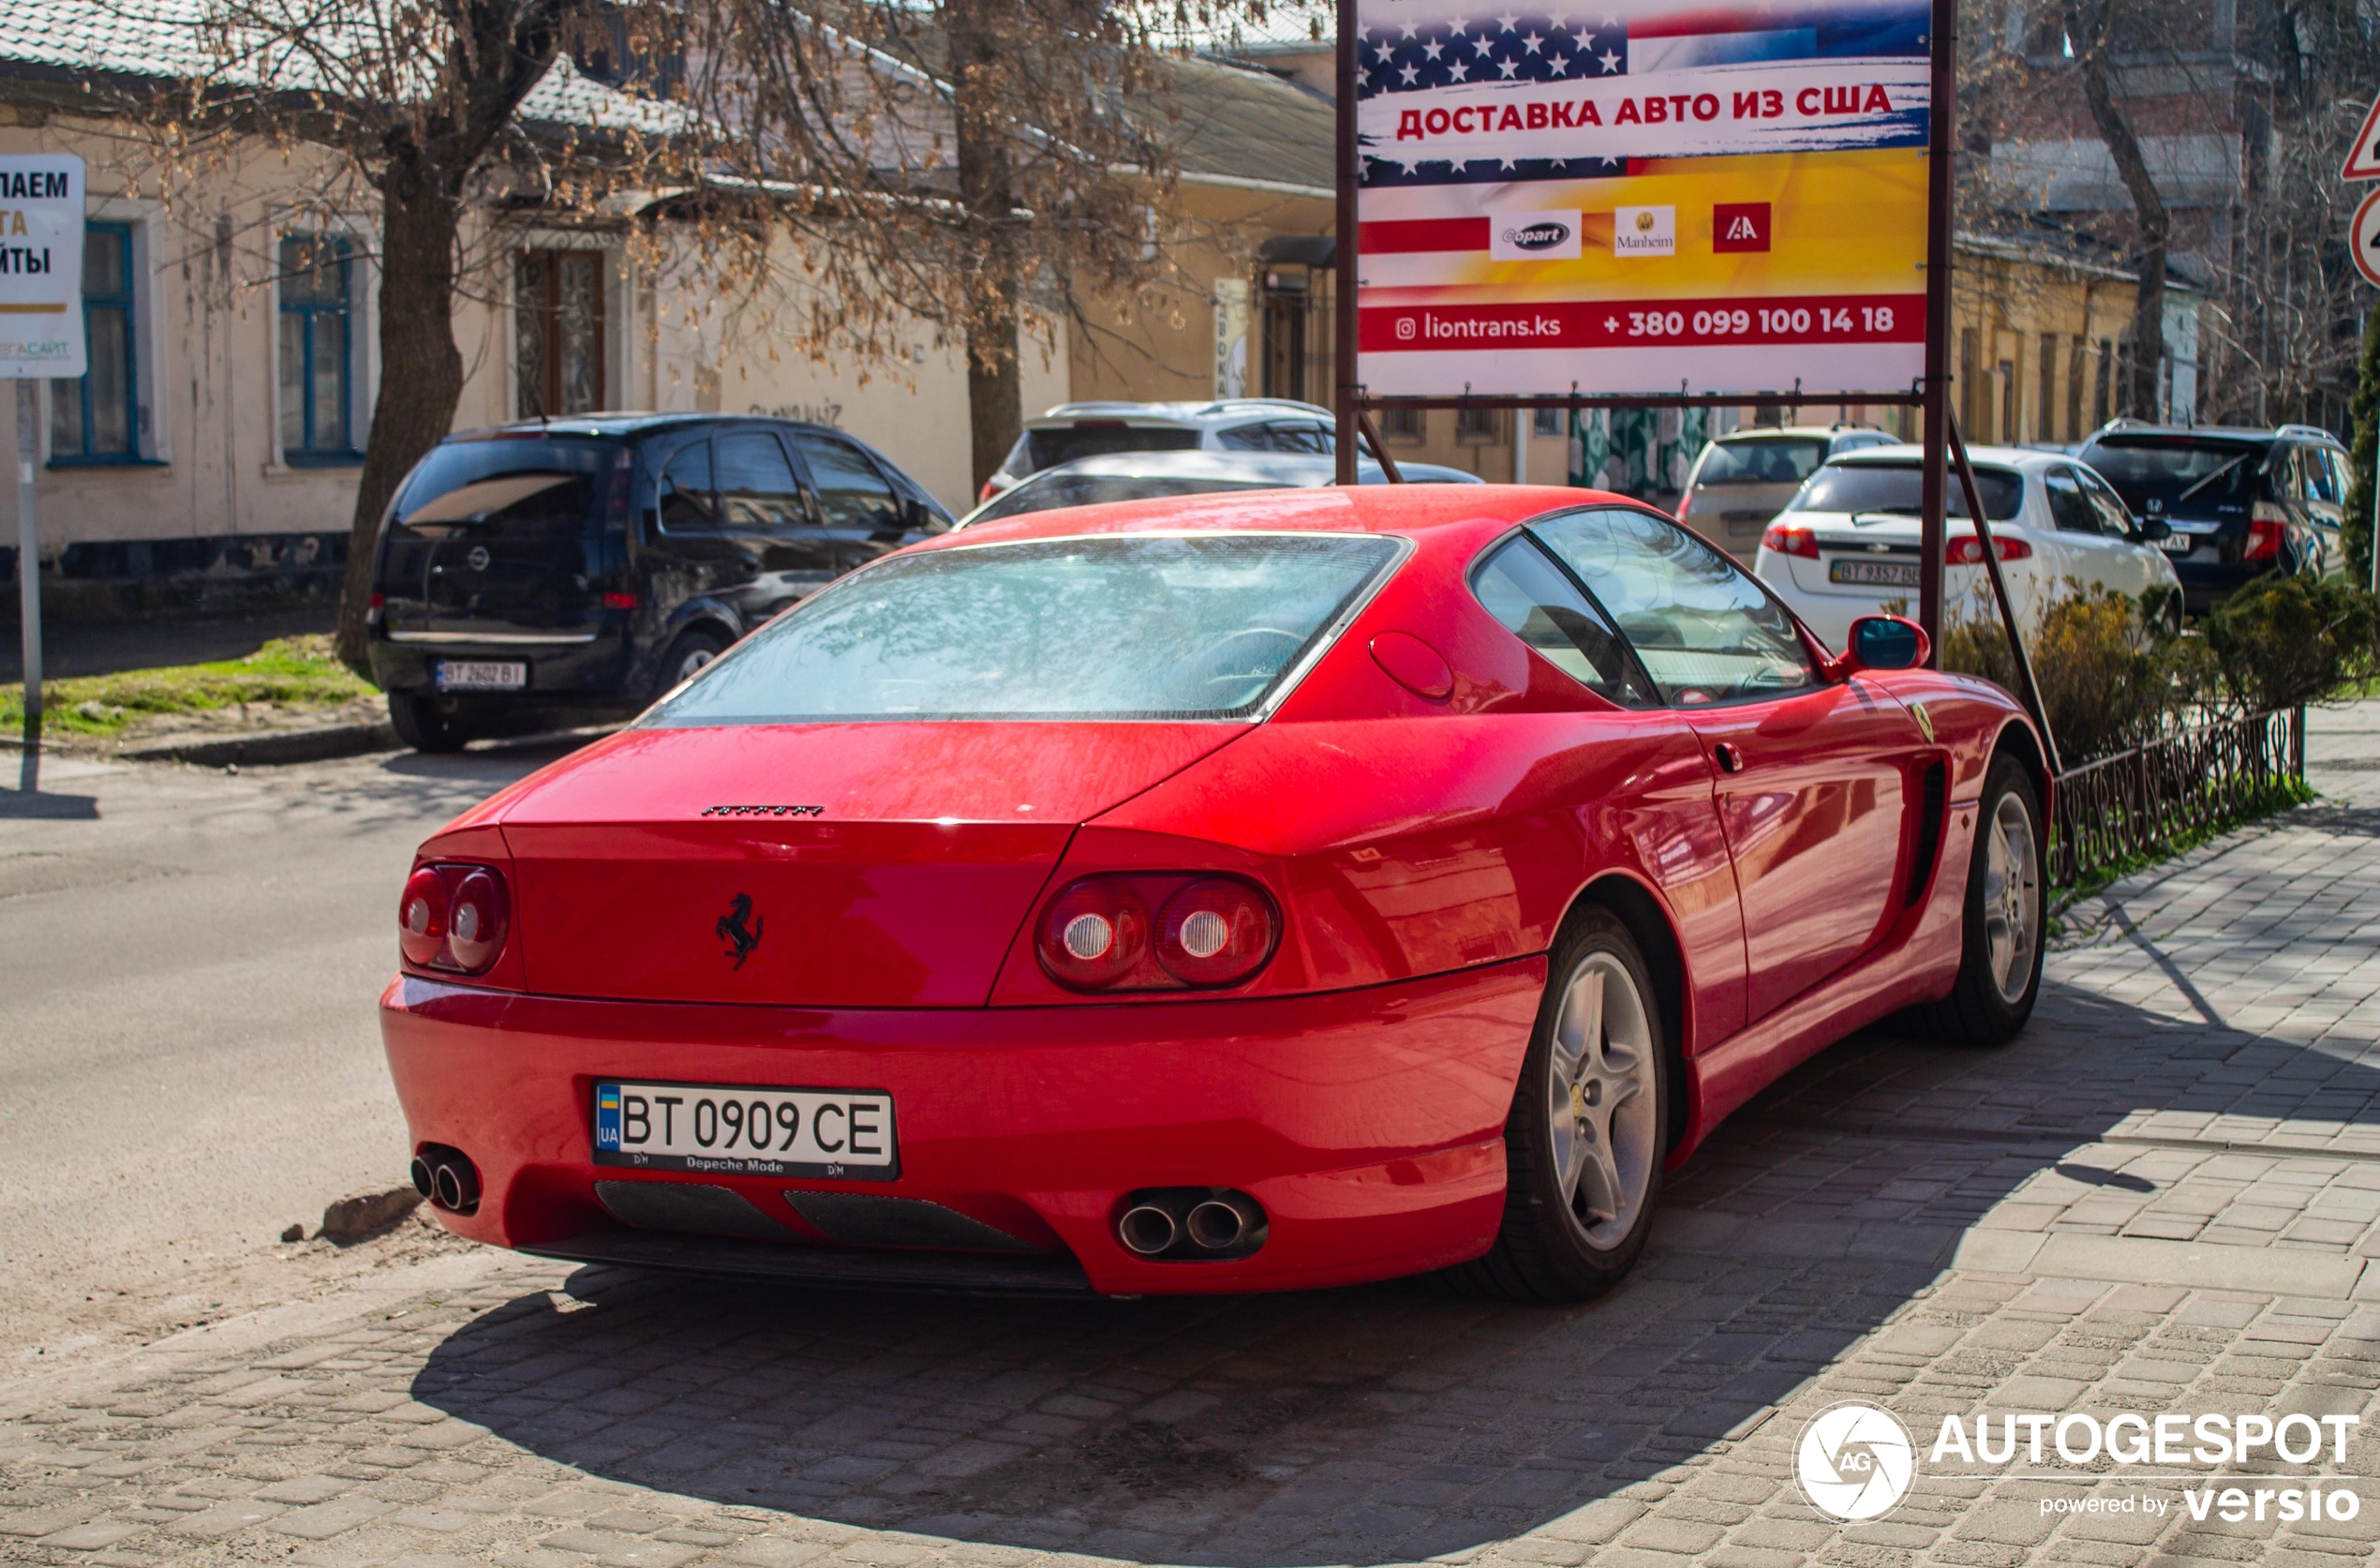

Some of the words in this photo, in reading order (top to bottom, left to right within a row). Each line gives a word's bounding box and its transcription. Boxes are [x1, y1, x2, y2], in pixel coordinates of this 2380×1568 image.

[1397, 100, 1602, 141] ДОСТАВКА
[1614, 93, 1720, 125] АВТО
[1733, 90, 1784, 119] ИЗ
[1796, 84, 1893, 116] США
[1503, 227, 1560, 244] Copart
[1617, 234, 1673, 248] Manheim
[1424, 312, 1561, 338] liontrans.ks
[1628, 311, 1684, 336] 380
[1692, 310, 1750, 335] 099
[1759, 308, 1811, 334] 100
[1820, 307, 1853, 333] 14
[1861, 306, 1895, 332] 18
[601, 1127, 618, 1143] UA
[623, 1095, 684, 1145] BT
[695, 1098, 800, 1151] 0909
[813, 1103, 882, 1155] CE
[687, 1157, 743, 1171] Depeche
[748, 1159, 784, 1172] Mode
